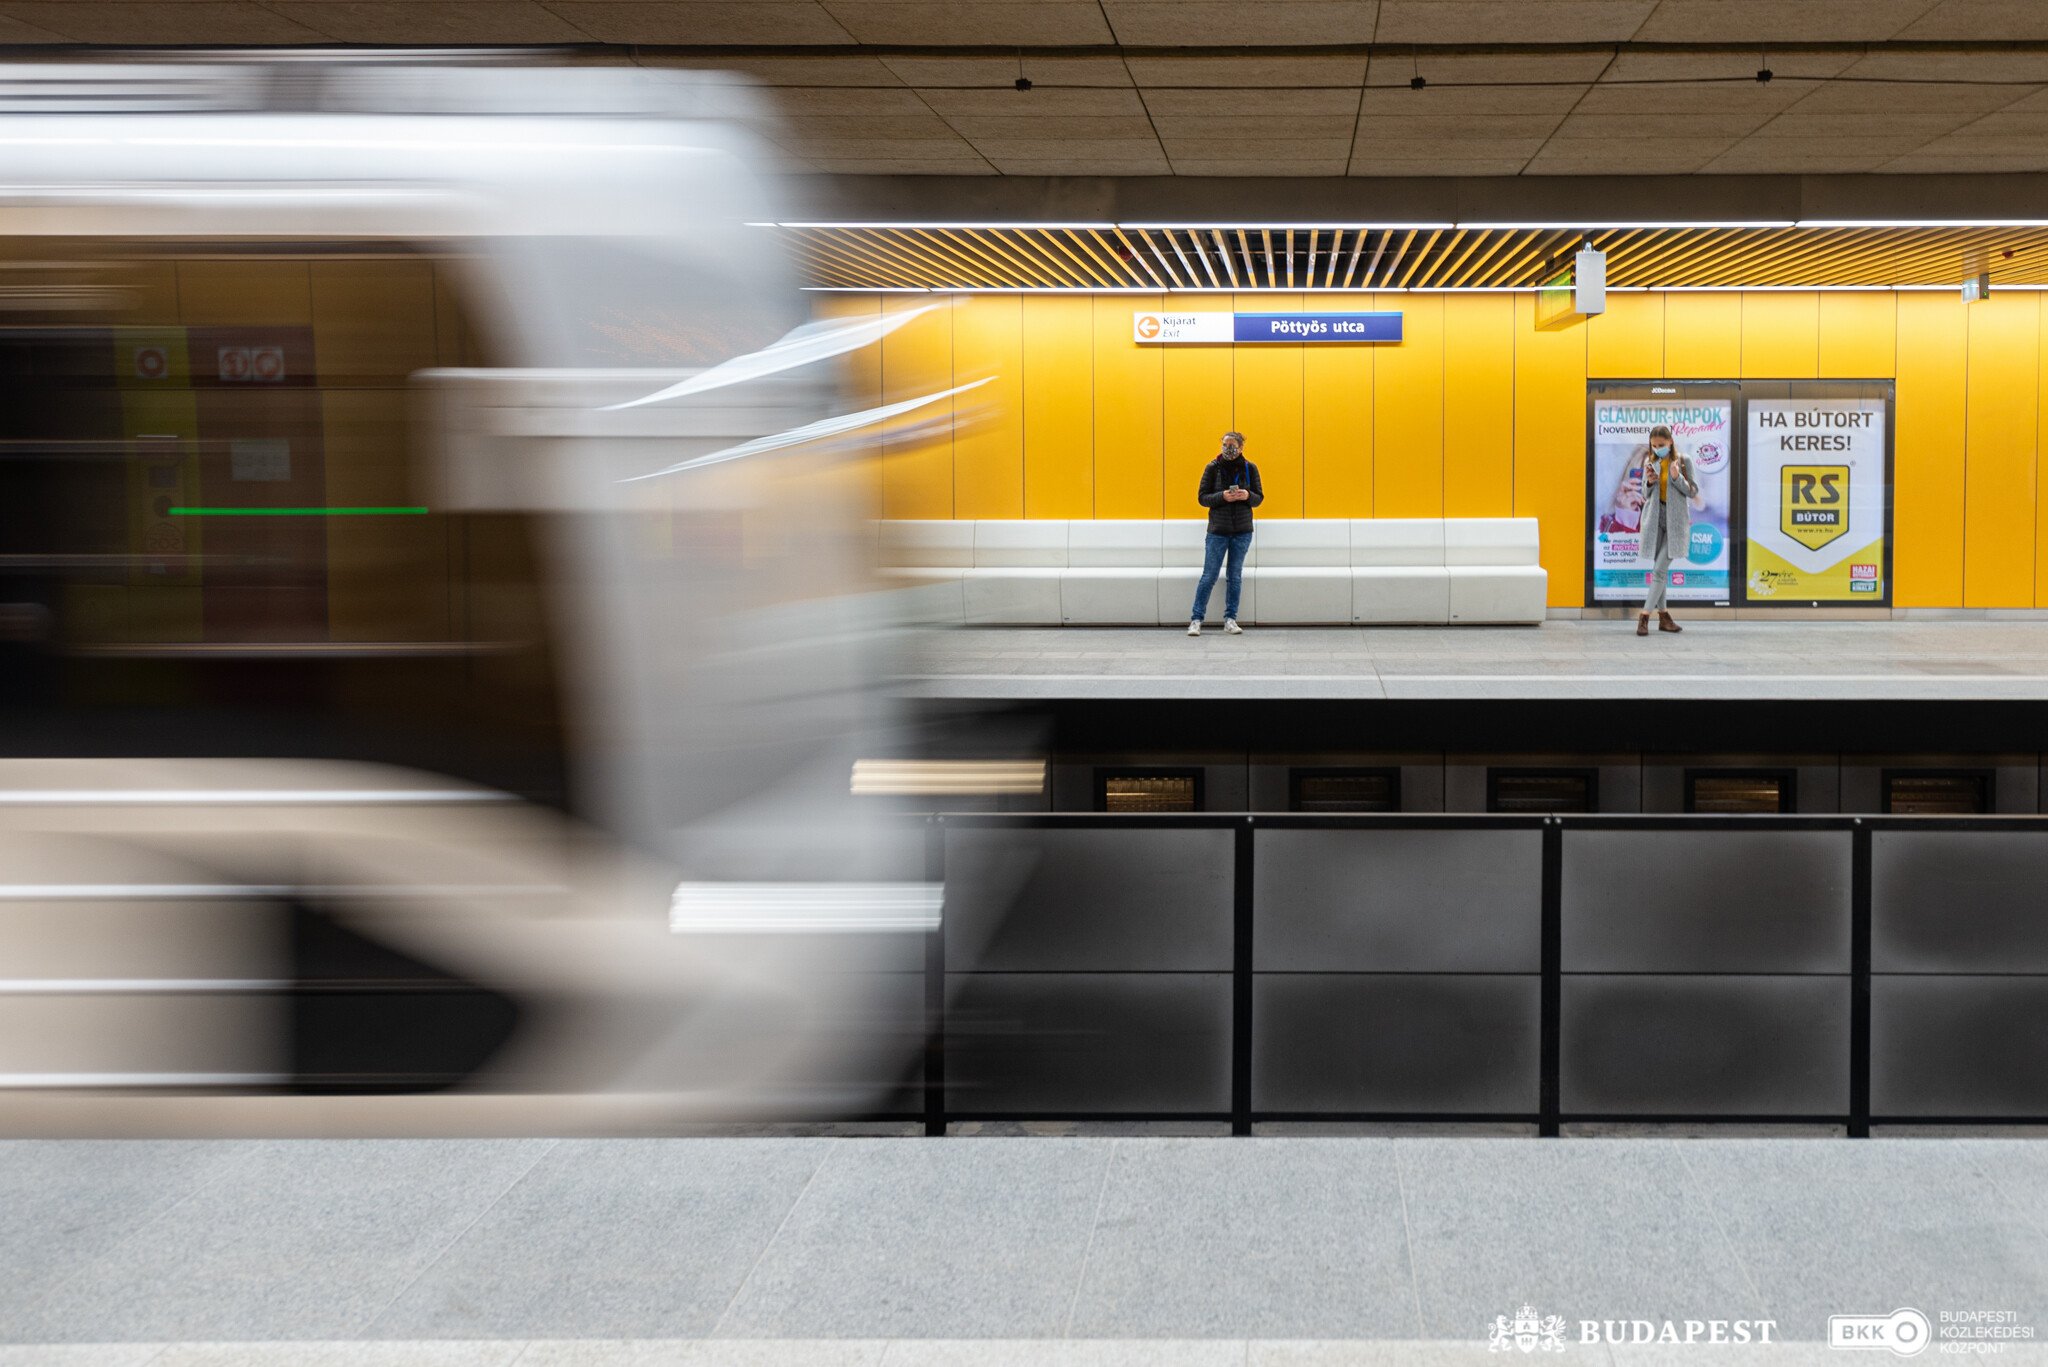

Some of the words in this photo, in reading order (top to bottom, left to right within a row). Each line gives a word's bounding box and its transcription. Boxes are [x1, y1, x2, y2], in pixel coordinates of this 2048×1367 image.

[1163, 329, 1180, 338] Exit
[1271, 319, 1327, 336] Pöttyös
[1333, 321, 1365, 333] utca
[1597, 406, 1722, 424] GLAMOUR-NAPOK
[1760, 412, 1787, 427] HA
[1794, 407, 1873, 427] BÚTORT
[1780, 435, 1851, 451] KERES!
[1791, 473, 1840, 504] RS
[1796, 511, 1835, 522] BÚTOR
[1691, 532, 1713, 545] CSAK
